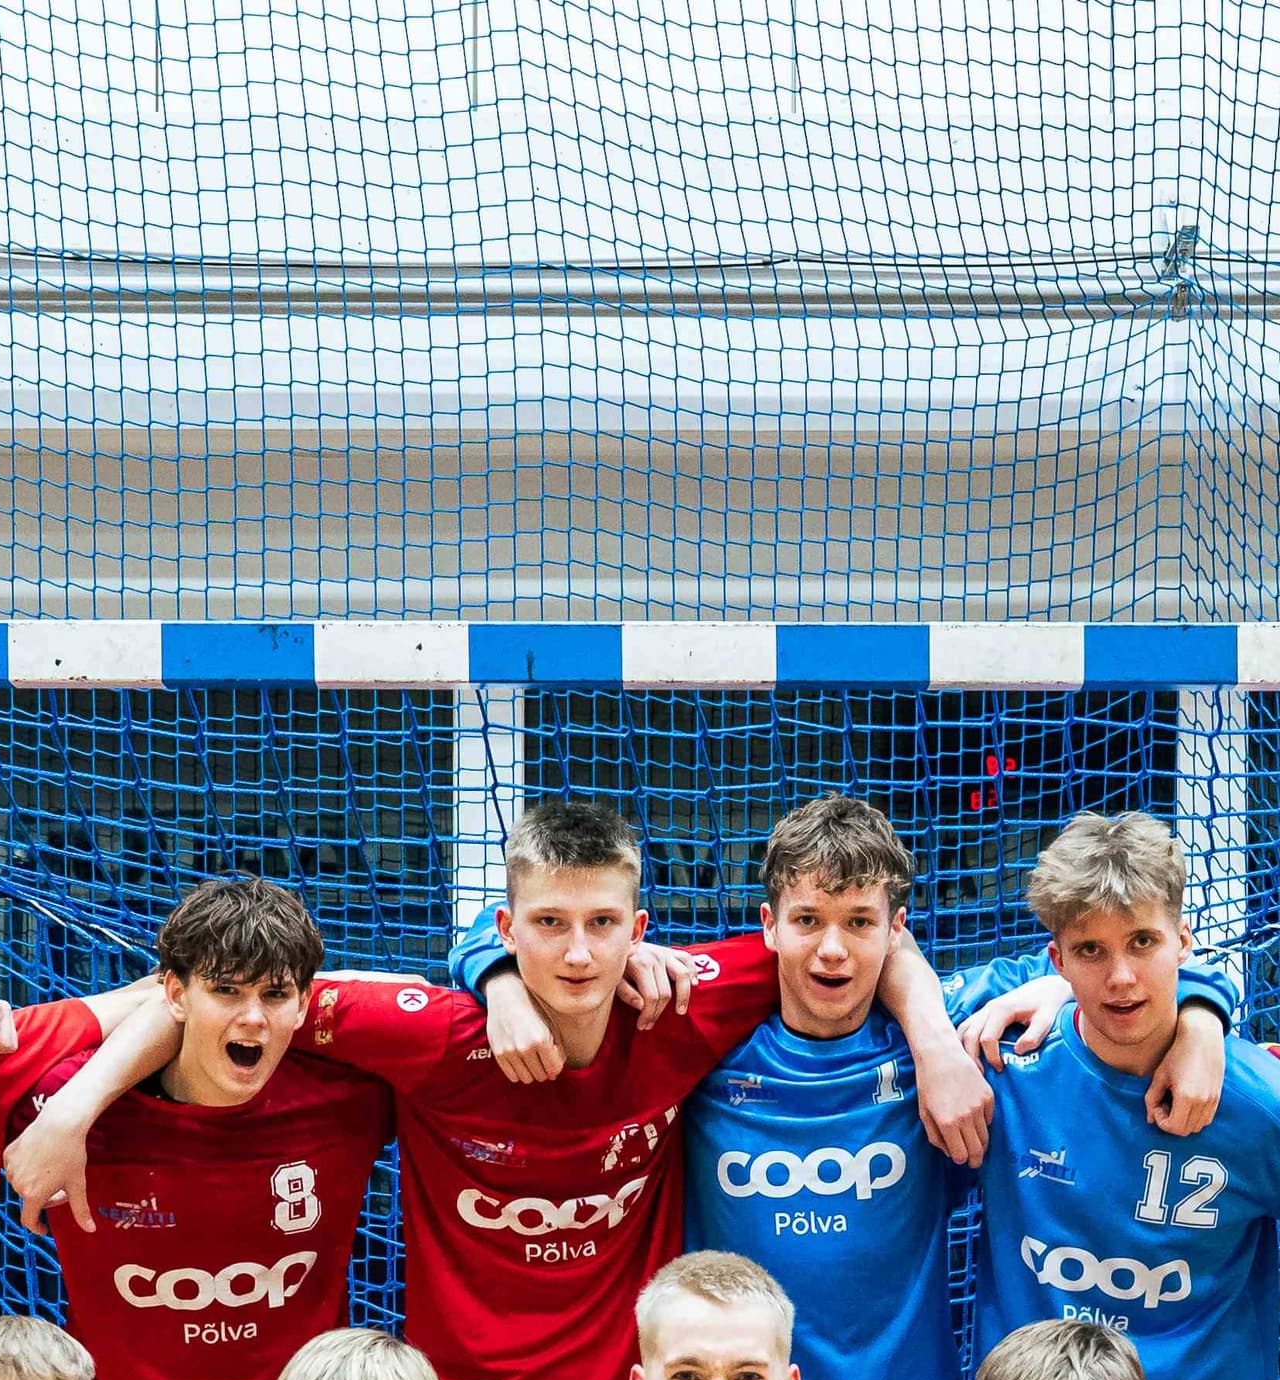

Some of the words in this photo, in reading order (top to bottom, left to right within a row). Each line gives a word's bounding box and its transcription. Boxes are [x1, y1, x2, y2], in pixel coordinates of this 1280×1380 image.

[872, 1059, 905, 1105] 1
[270, 1160, 322, 1235] 8
[717, 1141, 907, 1200] coop
[1134, 1149, 1229, 1229] 12
[456, 1174, 650, 1236] coop
[774, 1211, 847, 1236] Põlva
[114, 1250, 318, 1311] coop
[525, 1240, 597, 1263] Põlva
[1021, 1235, 1192, 1309] coop
[183, 1321, 258, 1345] Põlva
